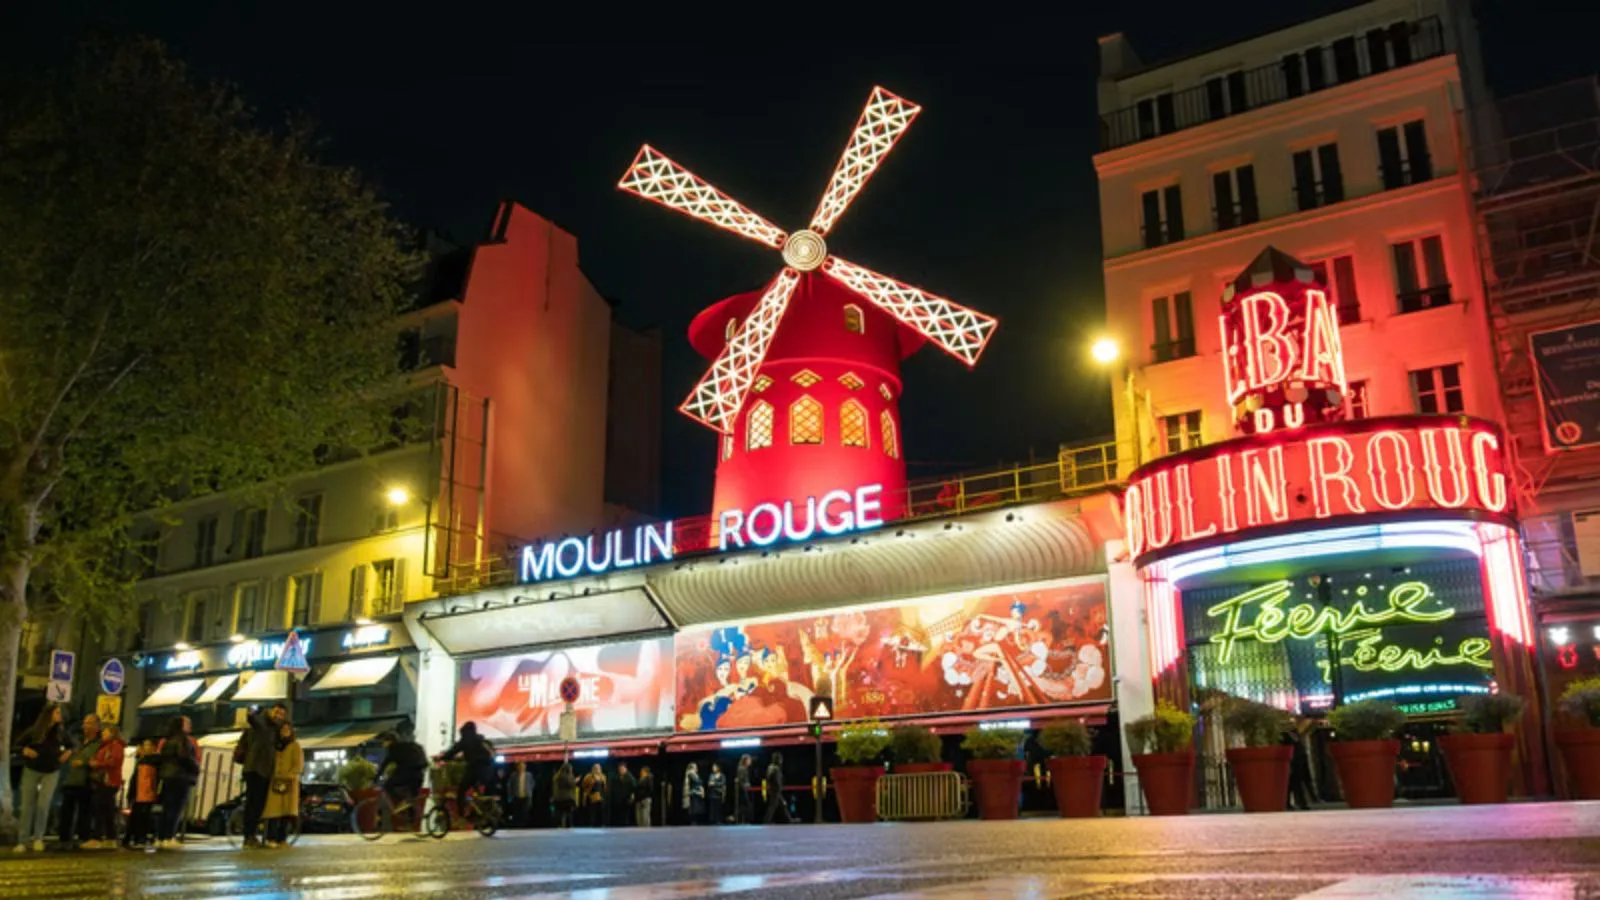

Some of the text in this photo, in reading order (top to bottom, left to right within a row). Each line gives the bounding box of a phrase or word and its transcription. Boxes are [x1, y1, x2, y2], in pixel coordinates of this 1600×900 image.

[1255, 403, 1304, 433] DU
[520, 484, 884, 582] MOULIN ROUGE
